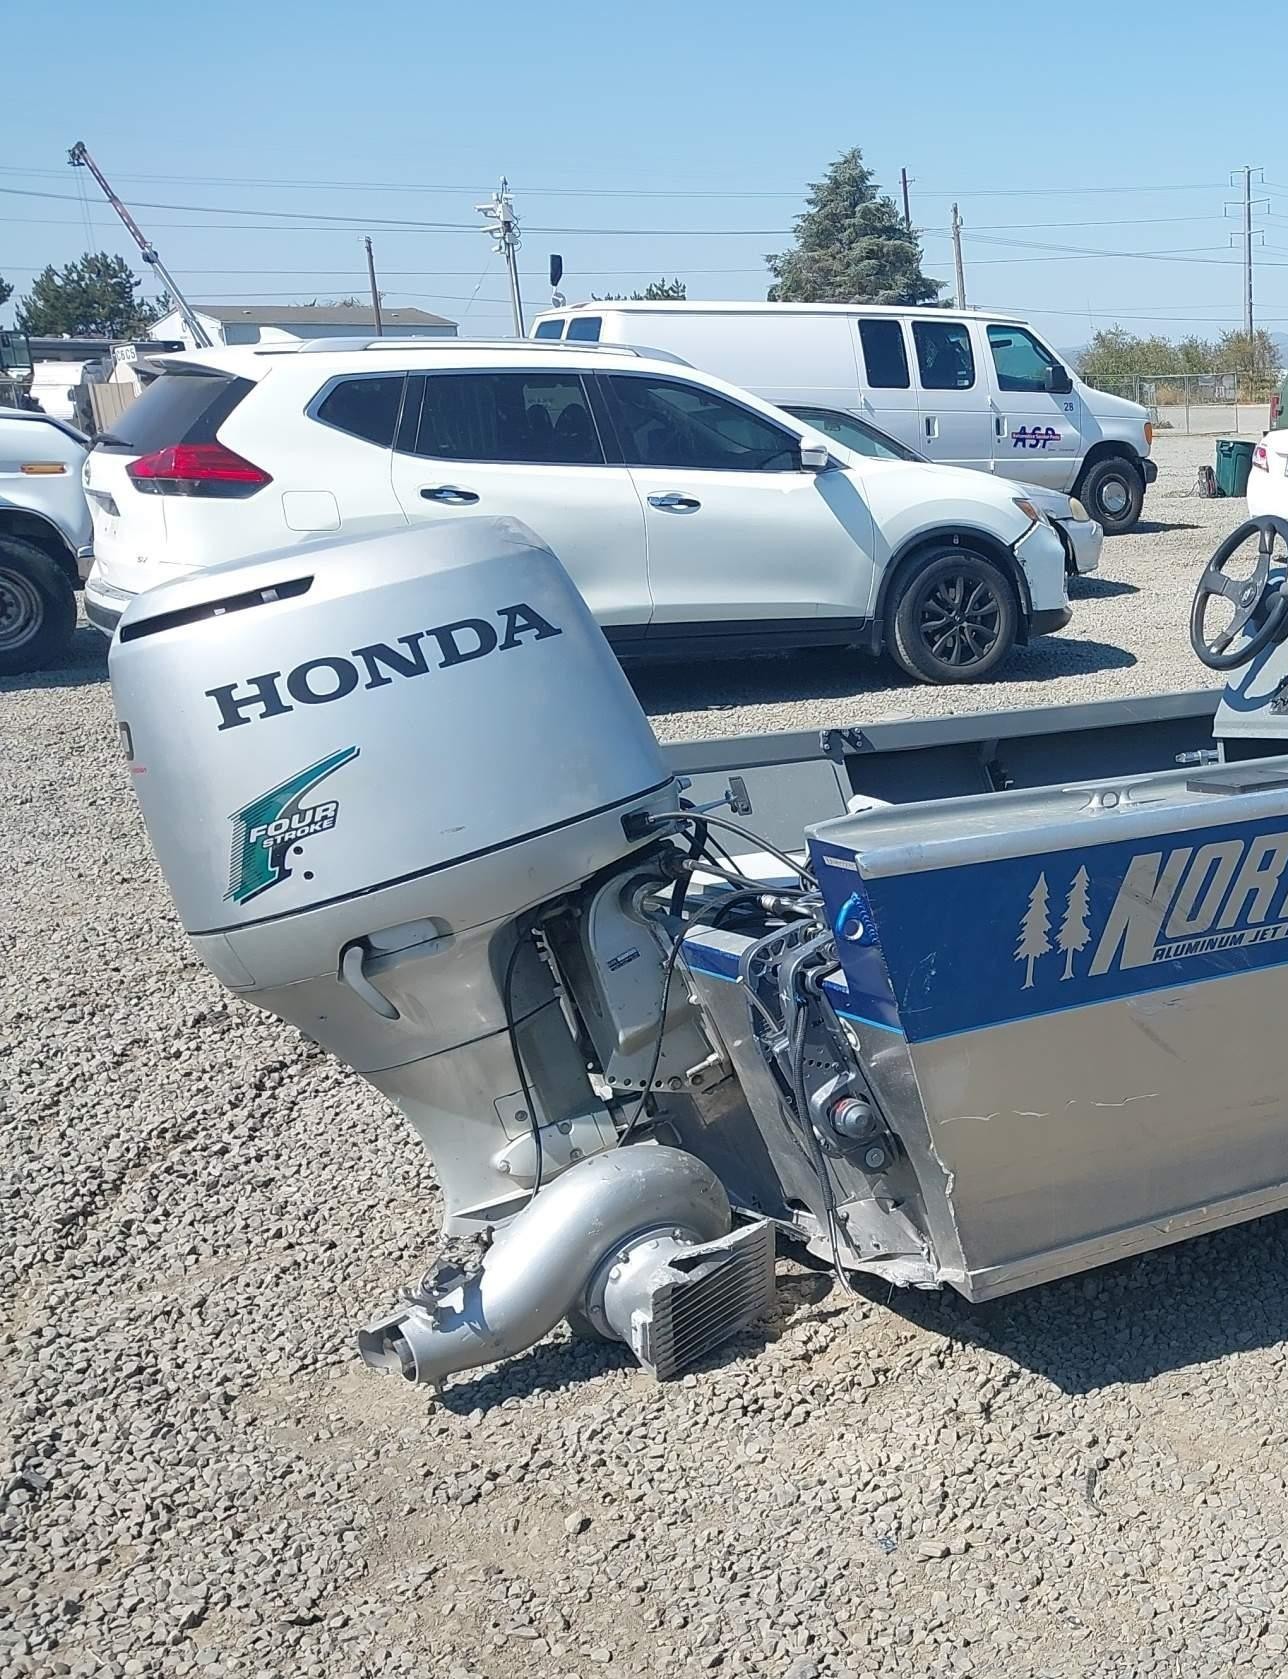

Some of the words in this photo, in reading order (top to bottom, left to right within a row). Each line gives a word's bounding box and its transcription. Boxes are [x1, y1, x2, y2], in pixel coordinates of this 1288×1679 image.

[1063, 402, 1074, 412] 28
[1012, 425, 1056, 449] ASP
[205, 603, 563, 731] HONDA
[249, 802, 337, 843] FOUR
[262, 818, 335, 848] STROKE
[1152, 933, 1245, 962] ALUMINUM
[1247, 926, 1278, 943] JET
